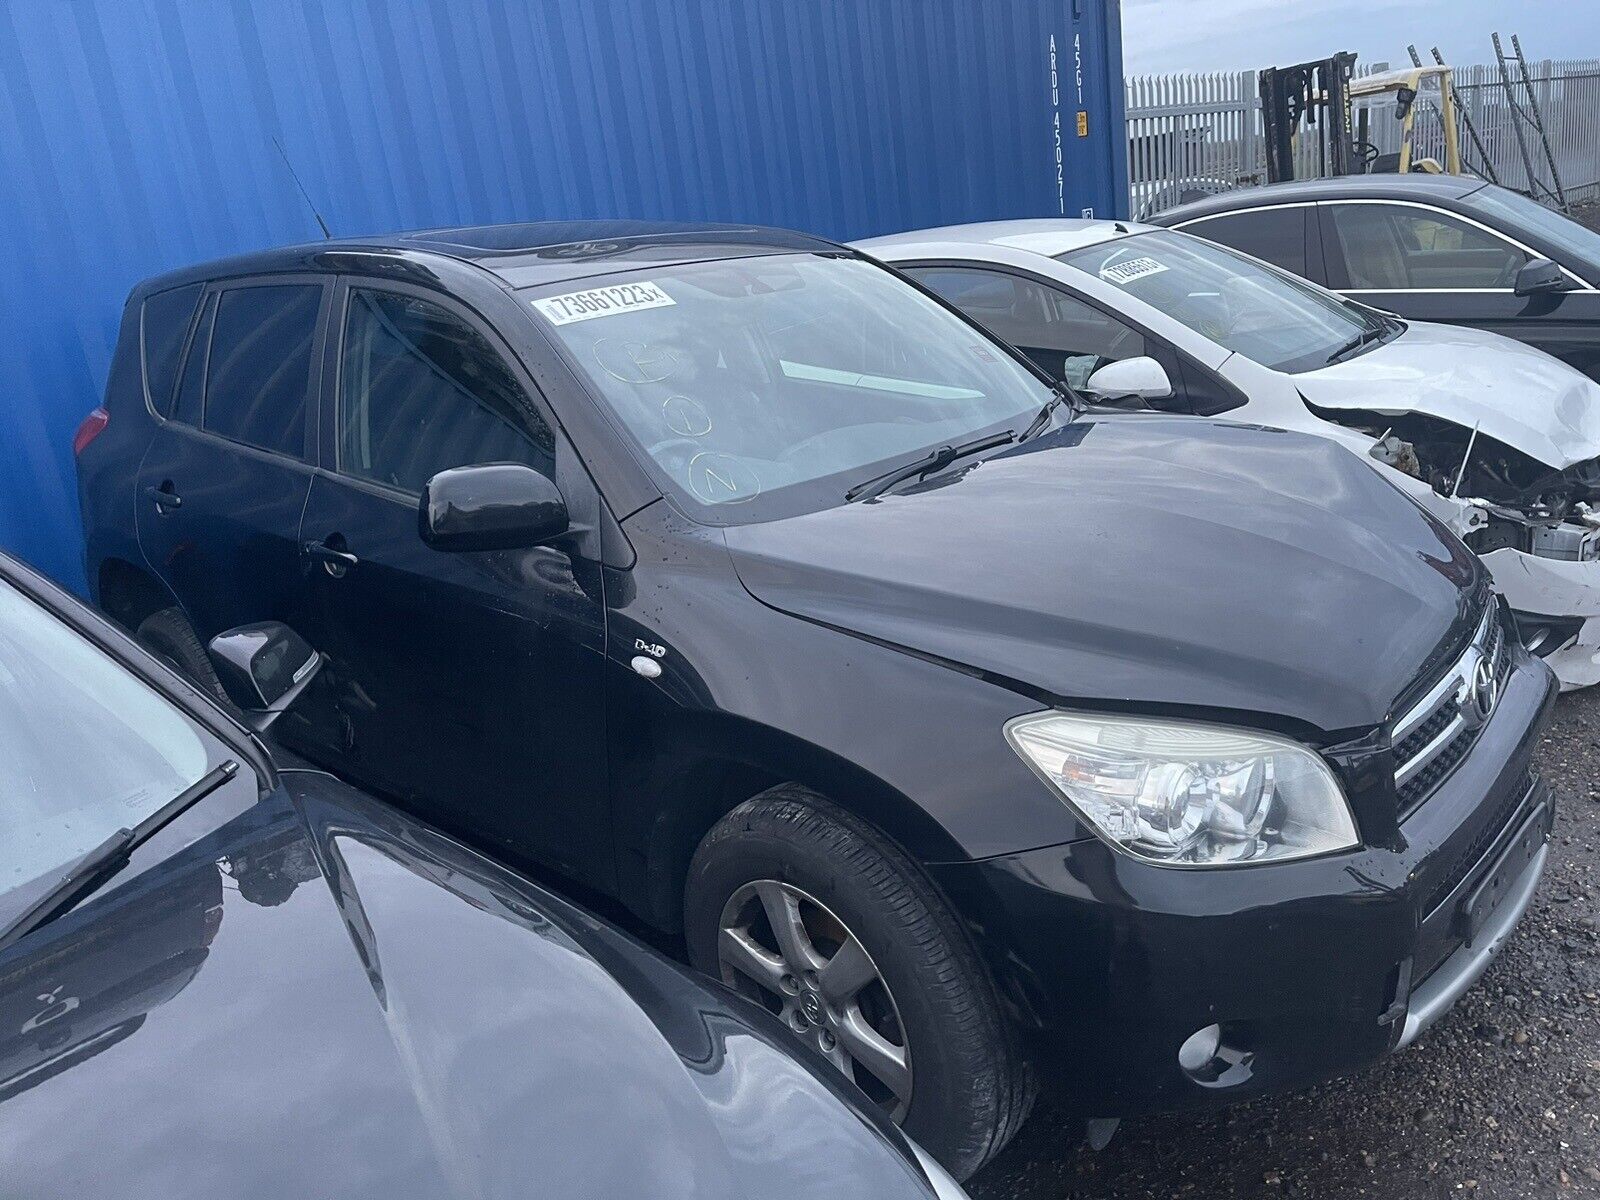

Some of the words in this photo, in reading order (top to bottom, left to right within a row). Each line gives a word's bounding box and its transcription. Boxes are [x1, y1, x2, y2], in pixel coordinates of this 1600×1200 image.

[1050, 34, 1059, 106] ARDU
[1074, 33, 1082, 104] 45G1
[1343, 83, 1351, 134] HYSTER
[1054, 111, 1064, 214] 450271
